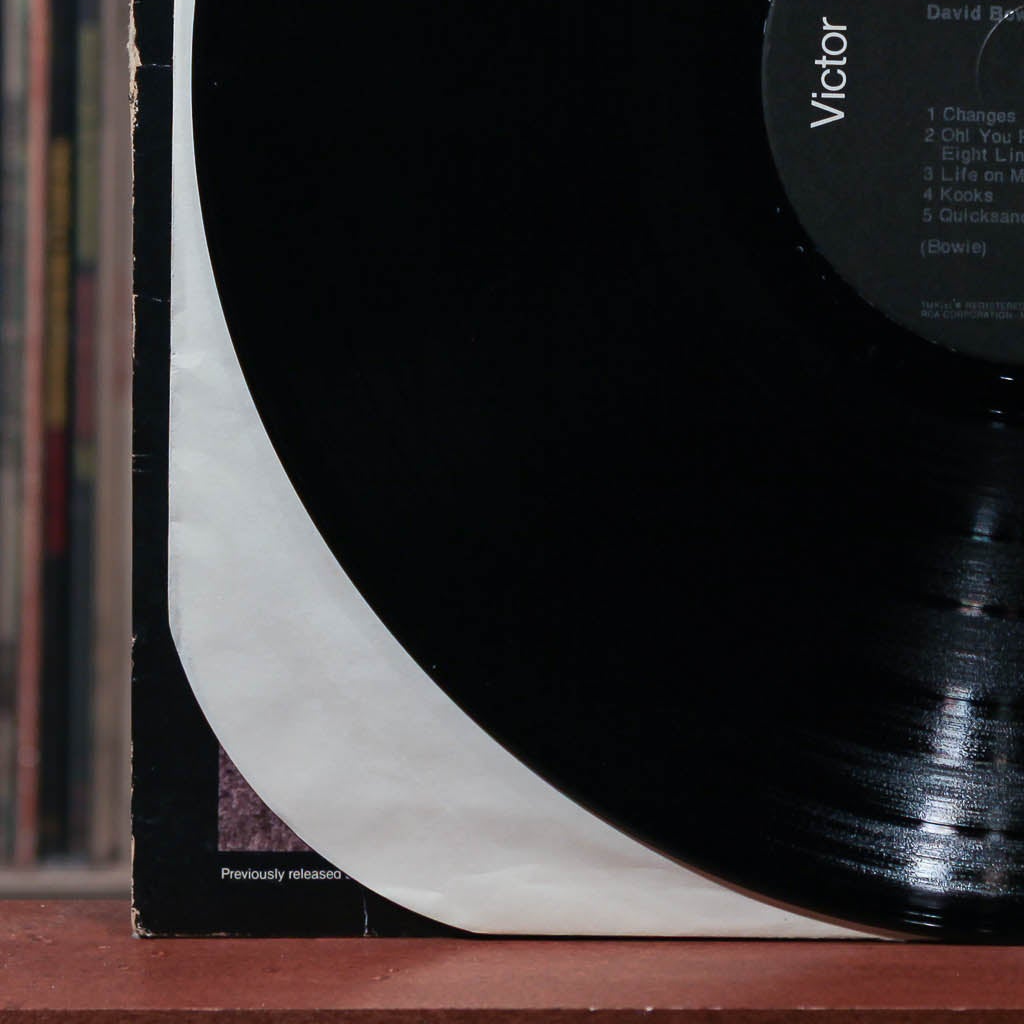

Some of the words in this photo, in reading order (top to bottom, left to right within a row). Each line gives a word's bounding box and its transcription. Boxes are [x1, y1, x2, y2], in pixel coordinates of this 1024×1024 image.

[927, 4, 981, 21] David
[810, 16, 848, 128] Victor
[927, 107, 935, 120] 1
[943, 107, 1016, 125] Changes
[924, 128, 934, 143] 2
[941, 128, 969, 143] Oh!
[979, 128, 1012, 145] You
[941, 146, 987, 164] Eight
[923, 167, 933, 182] 3
[941, 167, 978, 182] Life
[984, 170, 1004, 183] on
[923, 187, 932, 200] 4
[940, 187, 994, 203] Kooks
[922, 208, 932, 223] 5
[920, 239, 987, 258] (Bowie)
[221, 868, 285, 882] Previously
[288, 868, 341, 880] released
